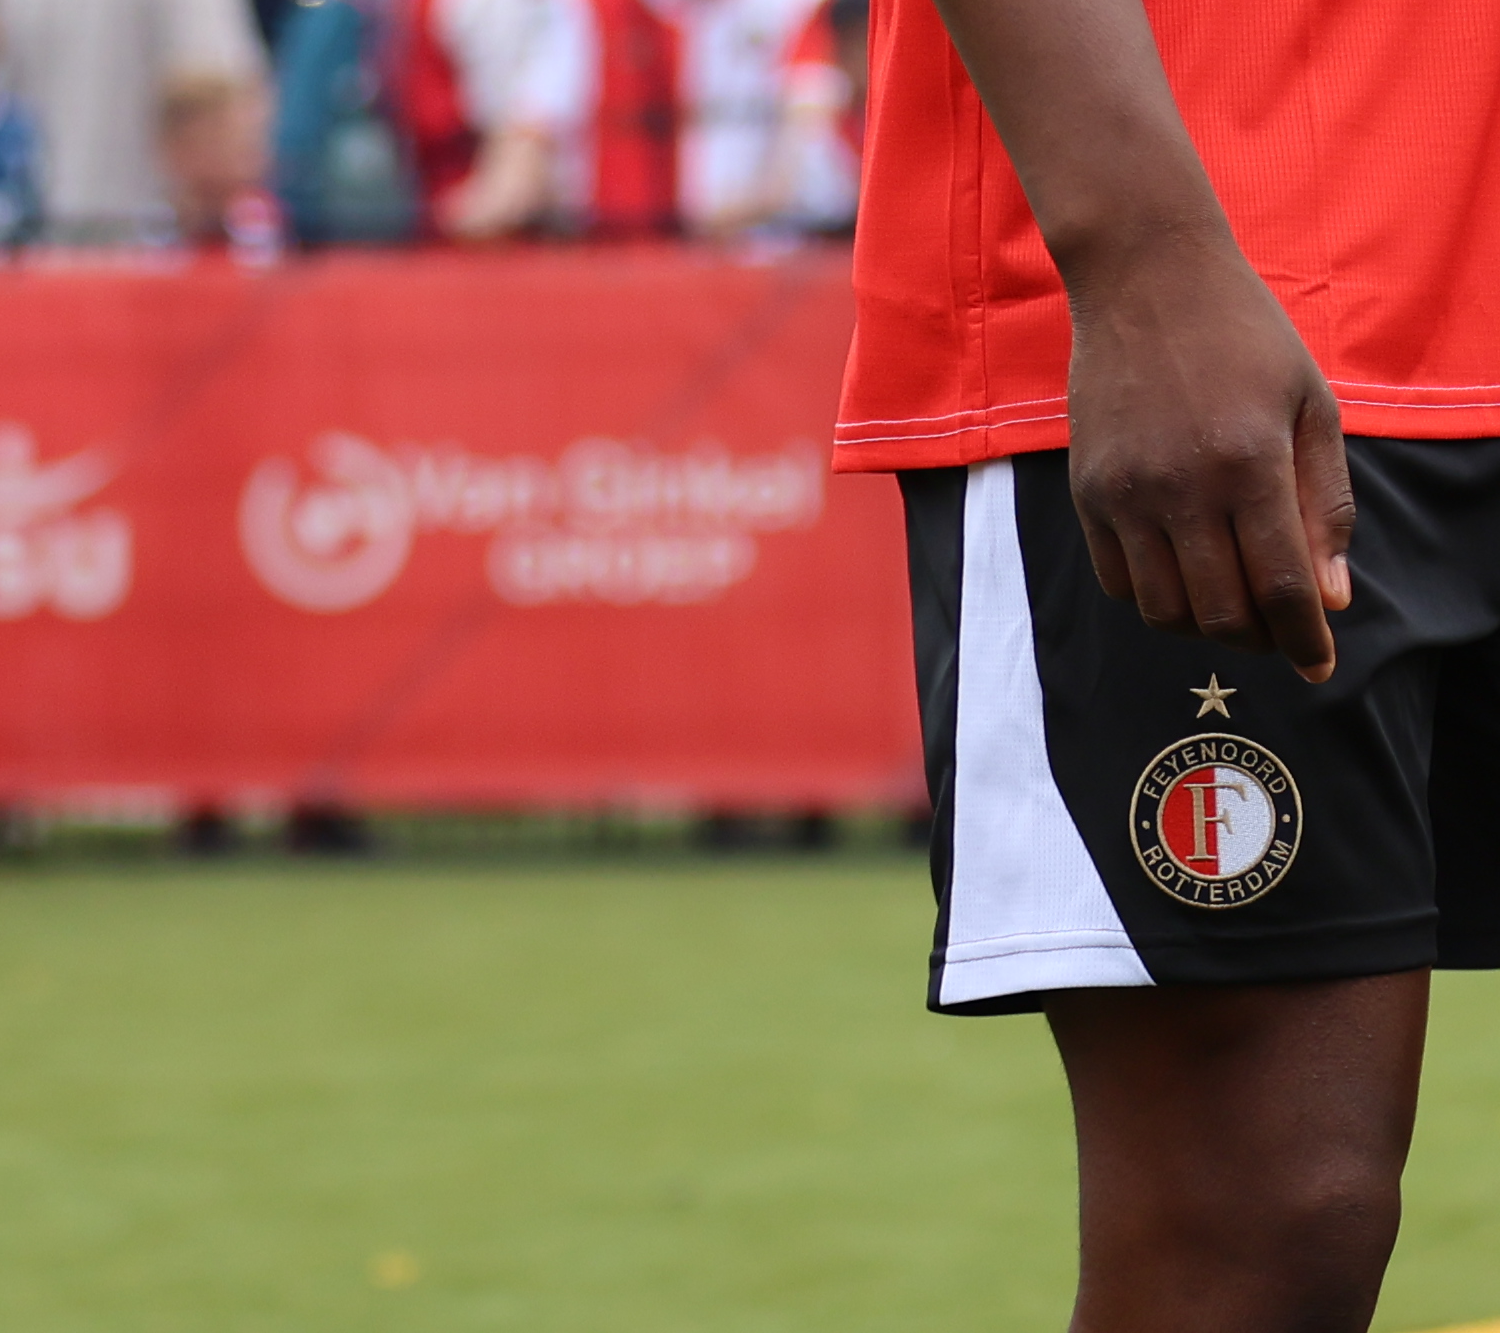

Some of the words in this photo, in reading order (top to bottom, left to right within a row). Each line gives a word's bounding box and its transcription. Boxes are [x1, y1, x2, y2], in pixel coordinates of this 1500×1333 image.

[1142, 741, 1288, 800] FEYENOORD
[1182, 782, 1248, 861] F
[1141, 838, 1293, 903] ROTTERDAM
